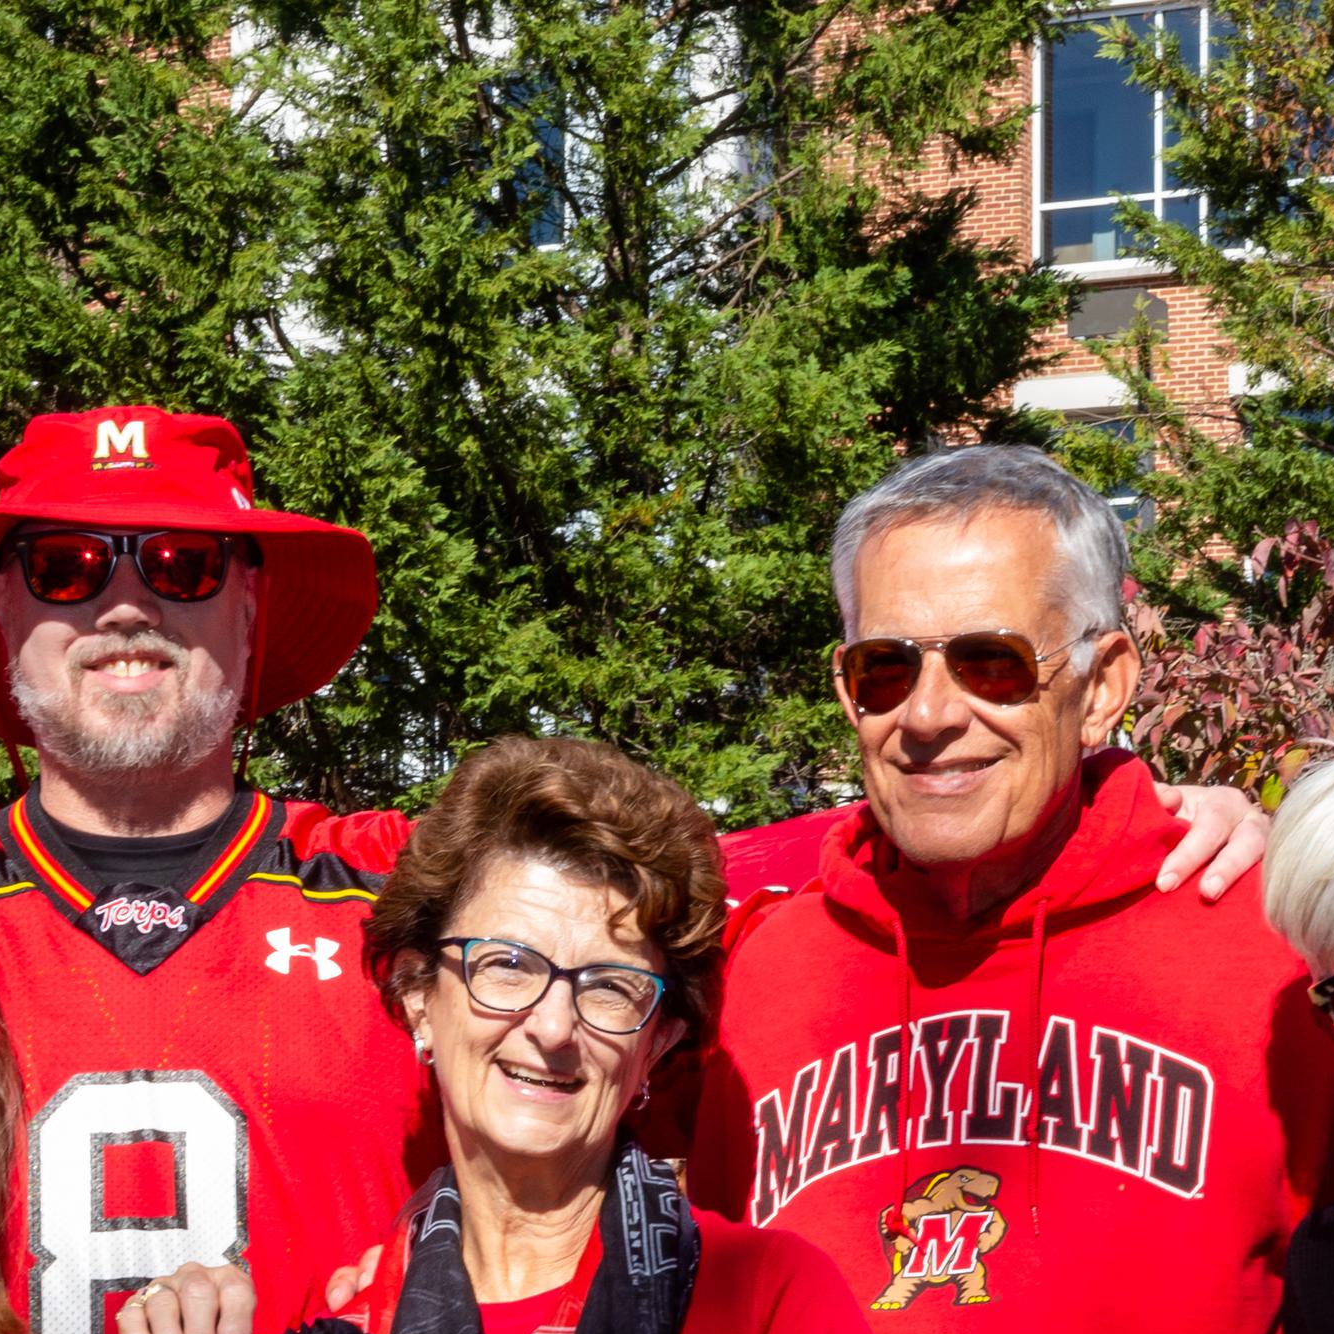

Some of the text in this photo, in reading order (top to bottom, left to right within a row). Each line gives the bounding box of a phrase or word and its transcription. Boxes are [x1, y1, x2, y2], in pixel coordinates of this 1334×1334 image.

[91, 418, 149, 460] M
[94, 896, 186, 934] Terps
[751, 1009, 1214, 1230] MARYLAND
[902, 1210, 994, 1279] M
